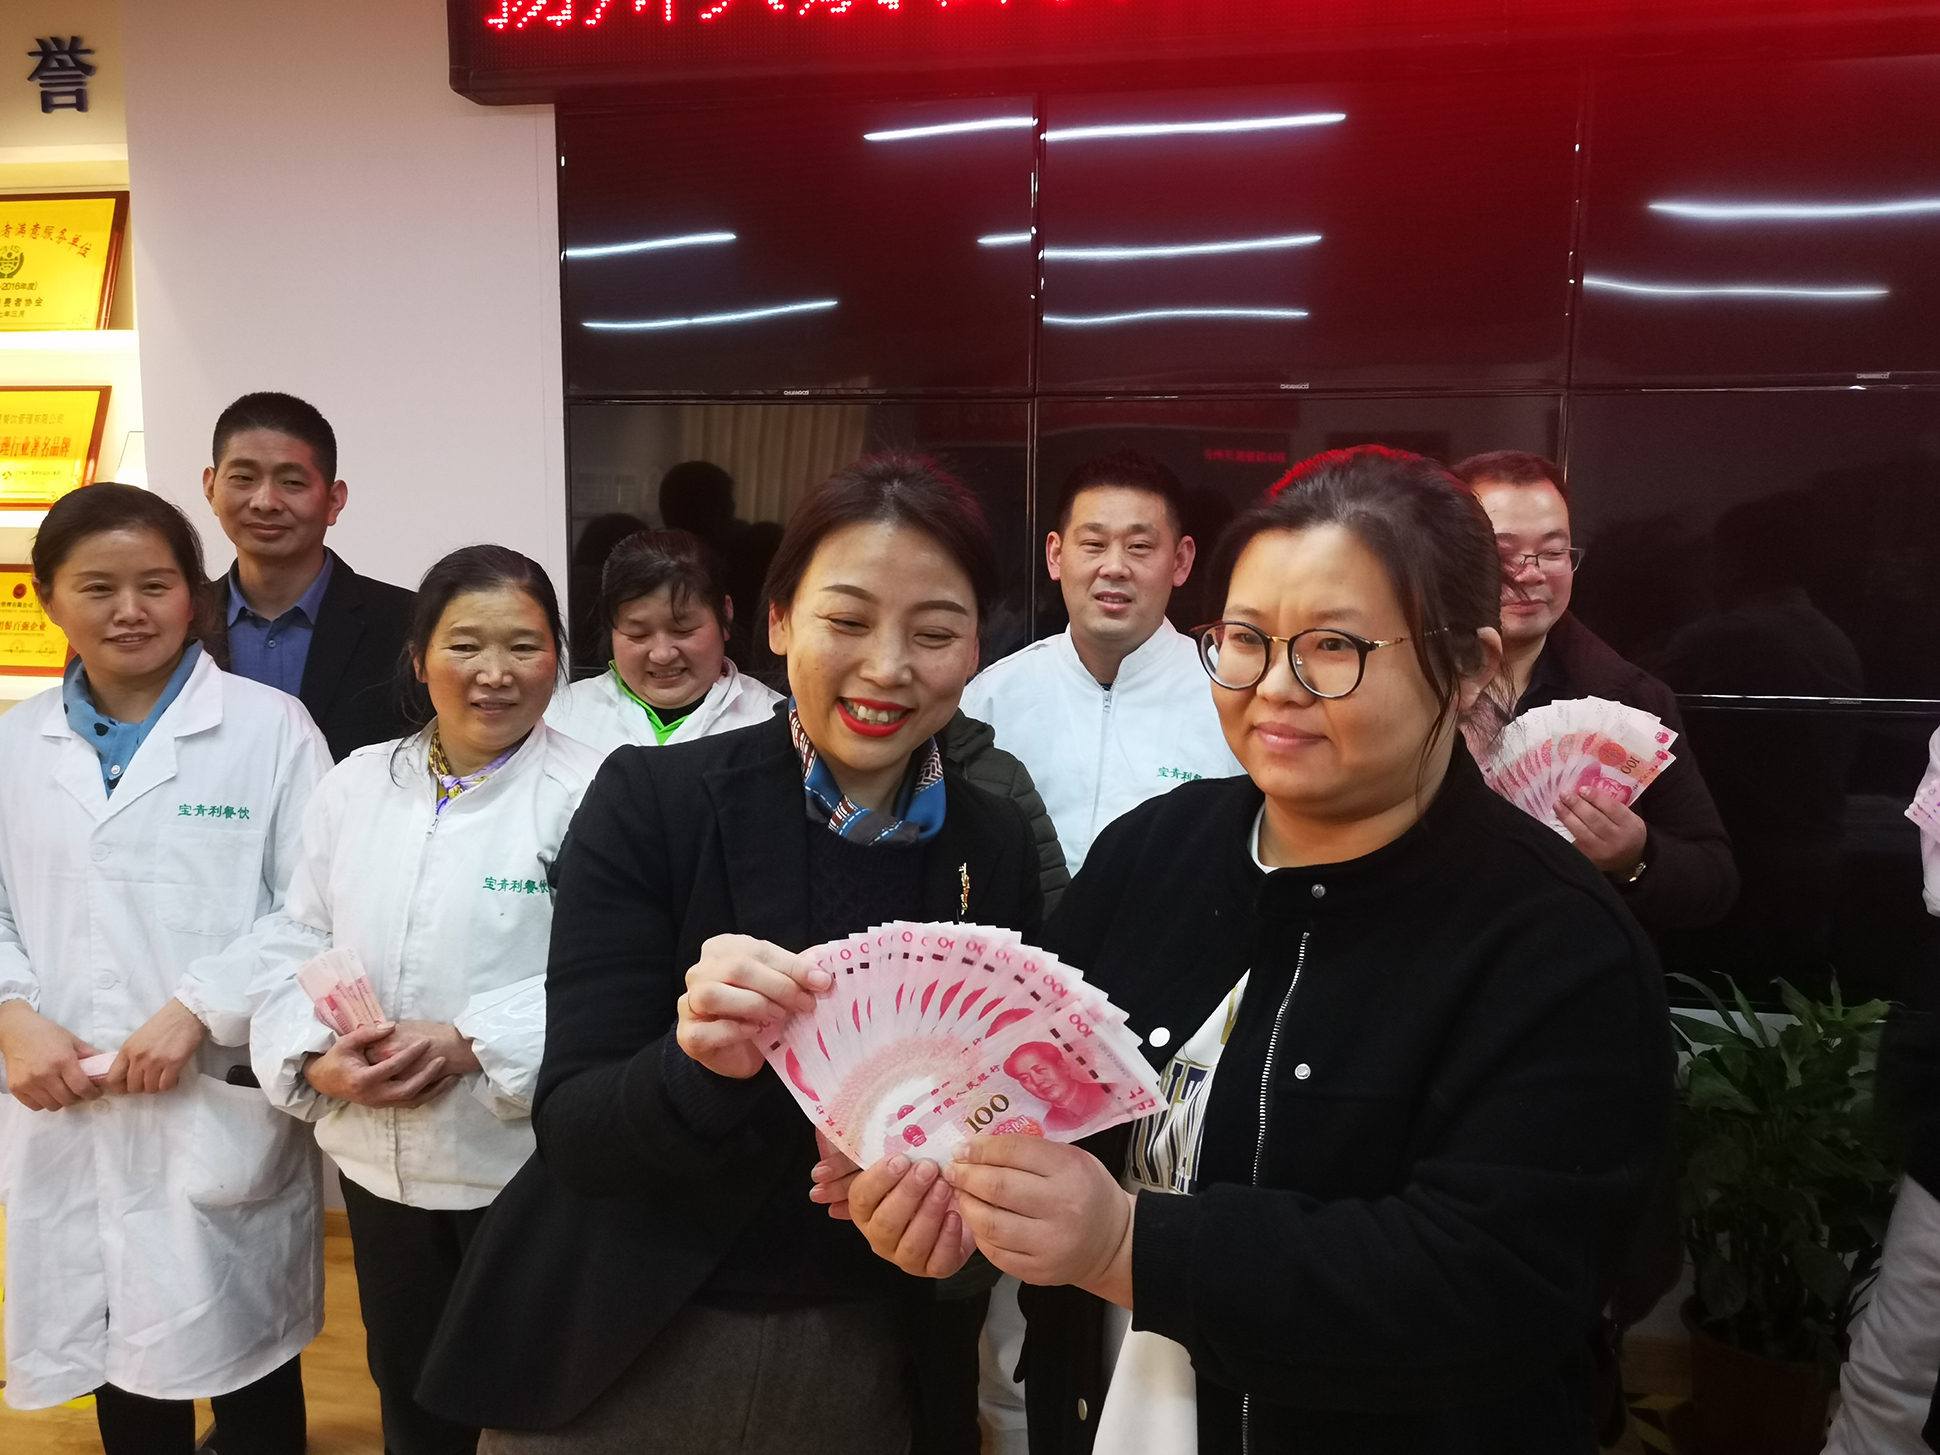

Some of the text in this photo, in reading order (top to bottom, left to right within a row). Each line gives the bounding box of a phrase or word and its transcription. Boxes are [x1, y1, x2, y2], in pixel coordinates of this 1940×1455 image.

[27, 36, 95, 113] 誉
[0, 413, 64, 424] 餐饮管理有限公司
[1620, 756, 1640, 775] 100
[177, 803, 250, 820] 宝青利餐饮
[1069, 1014, 1094, 1038] 100
[964, 1094, 1010, 1135] 100
